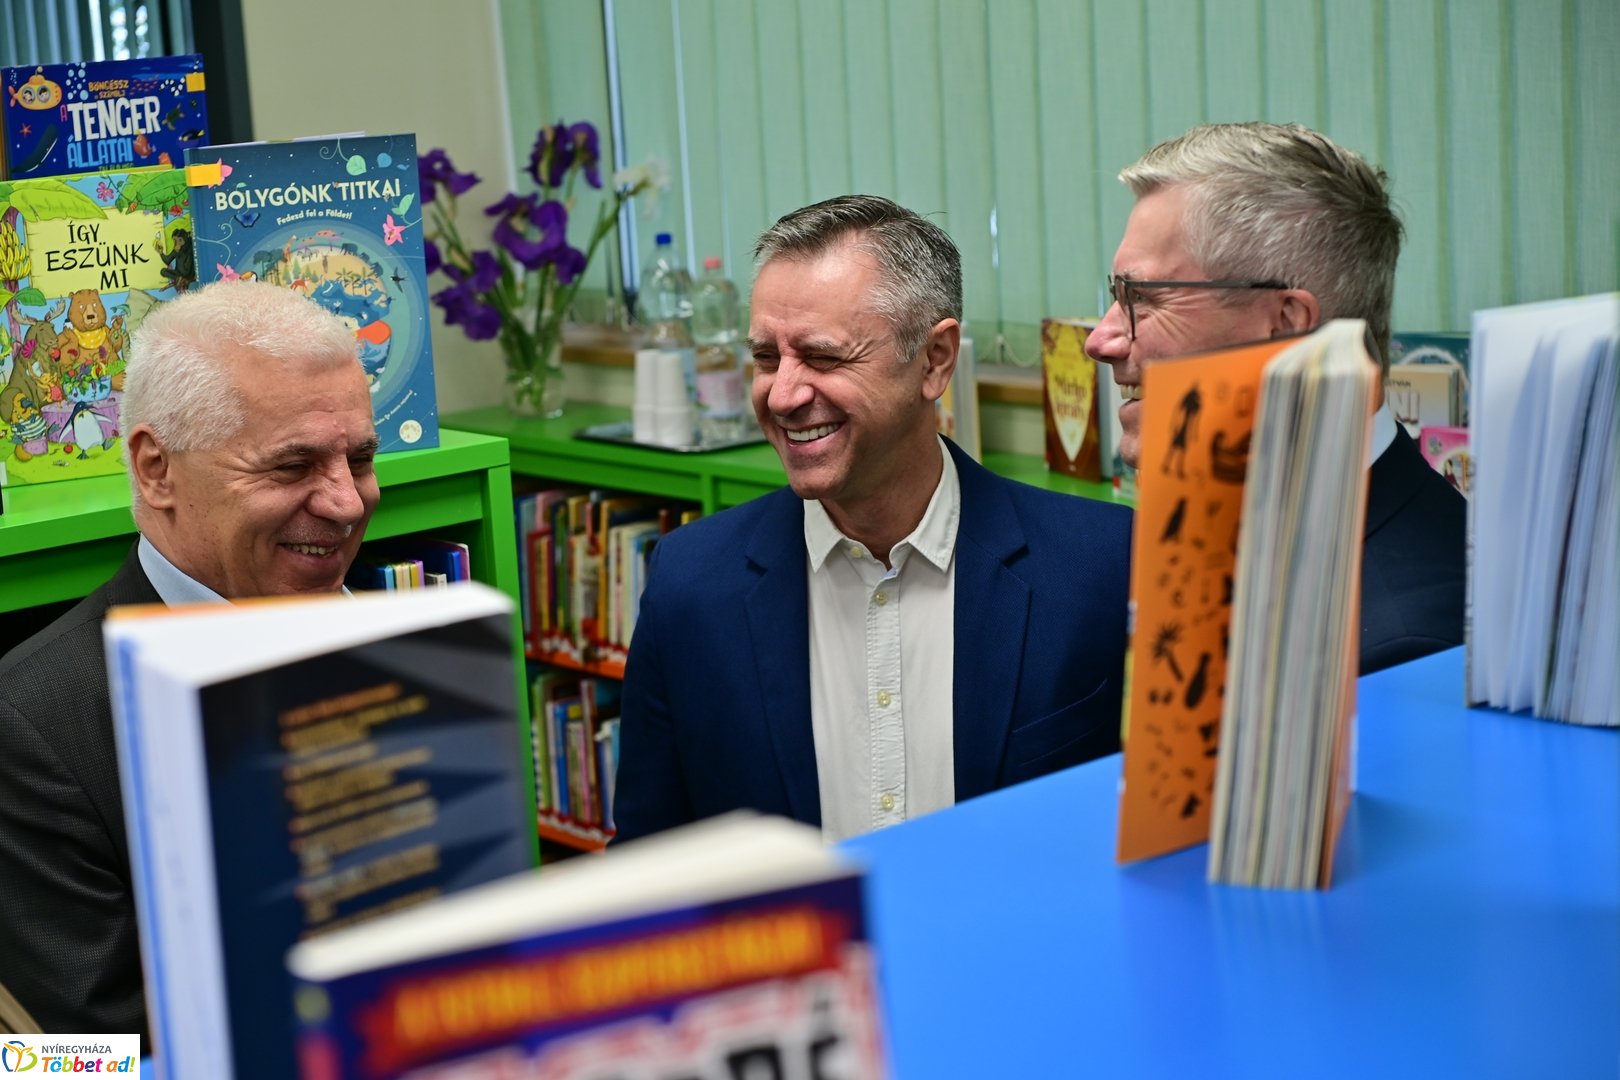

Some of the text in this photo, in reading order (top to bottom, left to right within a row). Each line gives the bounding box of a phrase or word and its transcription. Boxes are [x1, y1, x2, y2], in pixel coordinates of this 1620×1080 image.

[60, 96, 161, 142] A TENGER
[67, 134, 134, 168] ÁLLATAI
[215, 178, 401, 211] BOLYGÓNK TITKAI
[276, 210, 305, 226] Fedezd
[305, 208, 317, 218] fel
[325, 208, 353, 220] Földet!
[68, 220, 100, 245] ÍGY
[45, 242, 150, 272] ESZÜNK
[100, 268, 130, 291] MI
